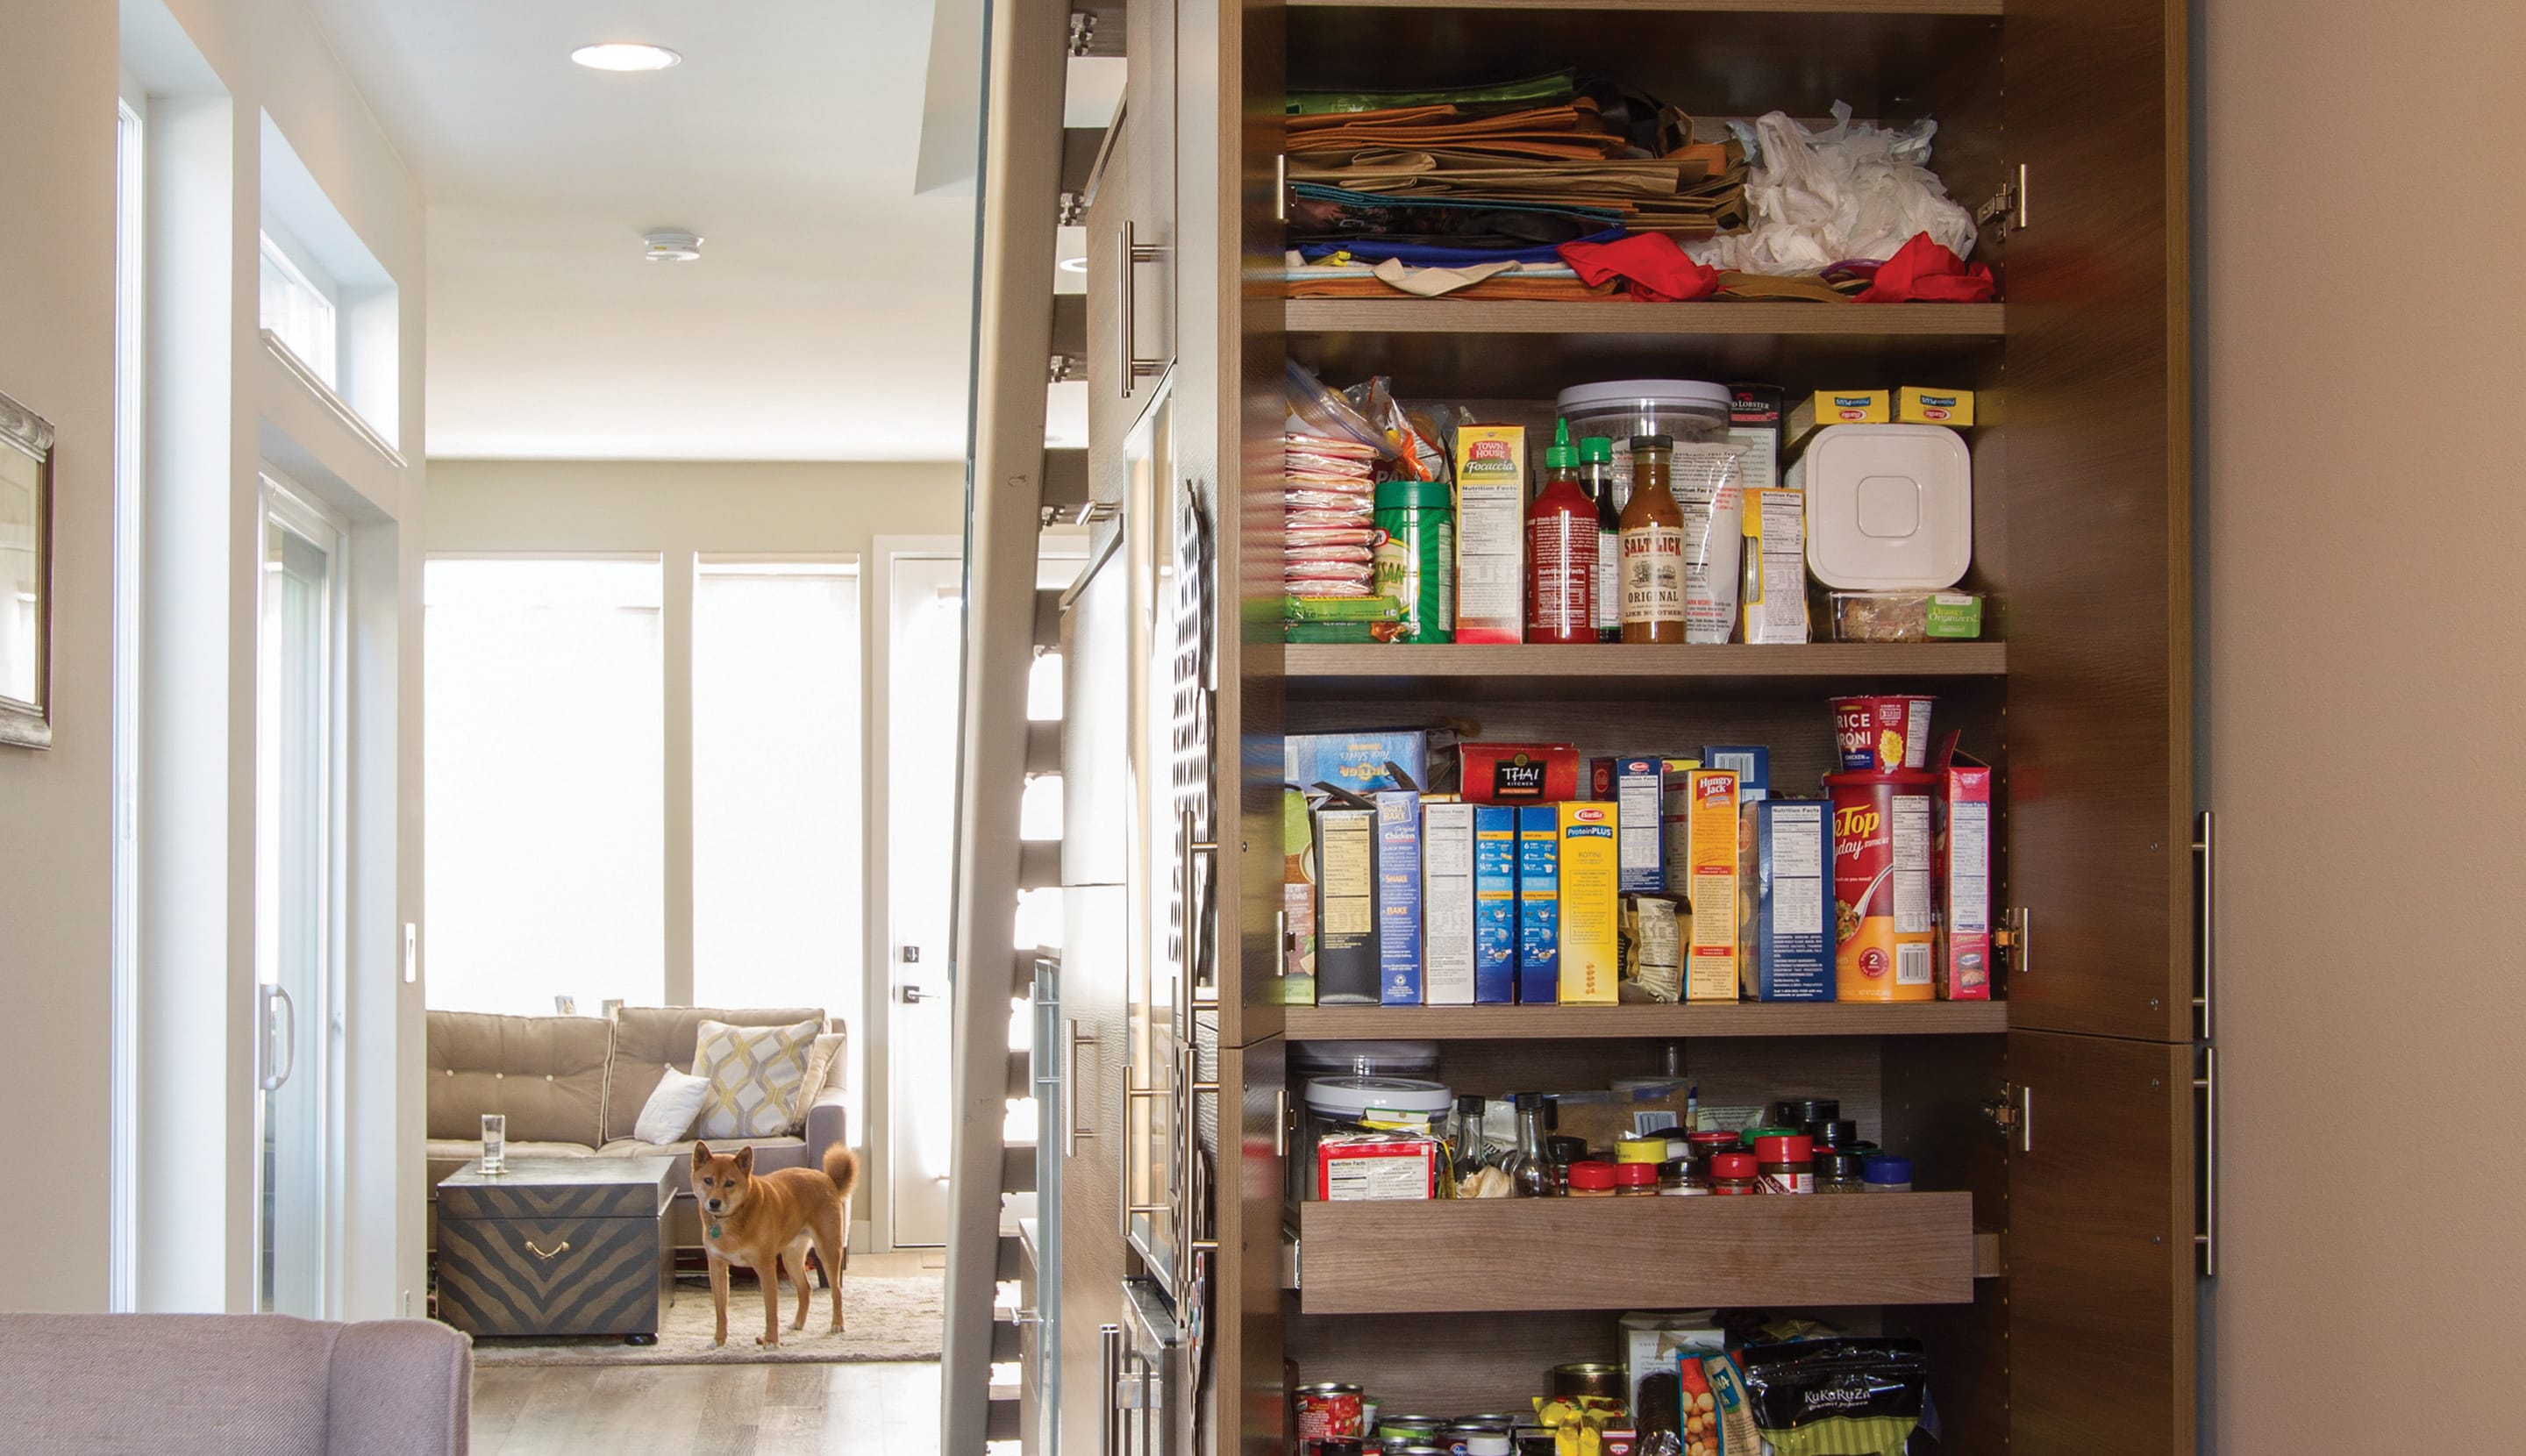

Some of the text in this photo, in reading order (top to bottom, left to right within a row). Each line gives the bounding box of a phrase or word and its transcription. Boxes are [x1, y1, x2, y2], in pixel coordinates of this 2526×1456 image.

[1476, 441, 1503, 450] TOWN
[1476, 450, 1505, 459] HOUSE
[1466, 460, 1515, 474] Focaccia
[1624, 538, 1652, 558] SALT
[1655, 537, 1681, 556] LICK
[1628, 591, 1679, 603] ORIGNAL
[1837, 713, 1871, 728] RICE
[1839, 731, 1872, 746] RONI
[1502, 767, 1539, 781] THAI
[1700, 776, 1733, 789] Hungry
[1704, 785, 1726, 796] Jack
[1383, 811, 1407, 821] BAKE
[1837, 803, 1880, 839] Top
[1567, 826, 1613, 837] ProteinPLUS
[1385, 874, 1409, 883] SHAKE
[1387, 906, 1408, 916] BAKE
[1869, 954, 1879, 965] 2
